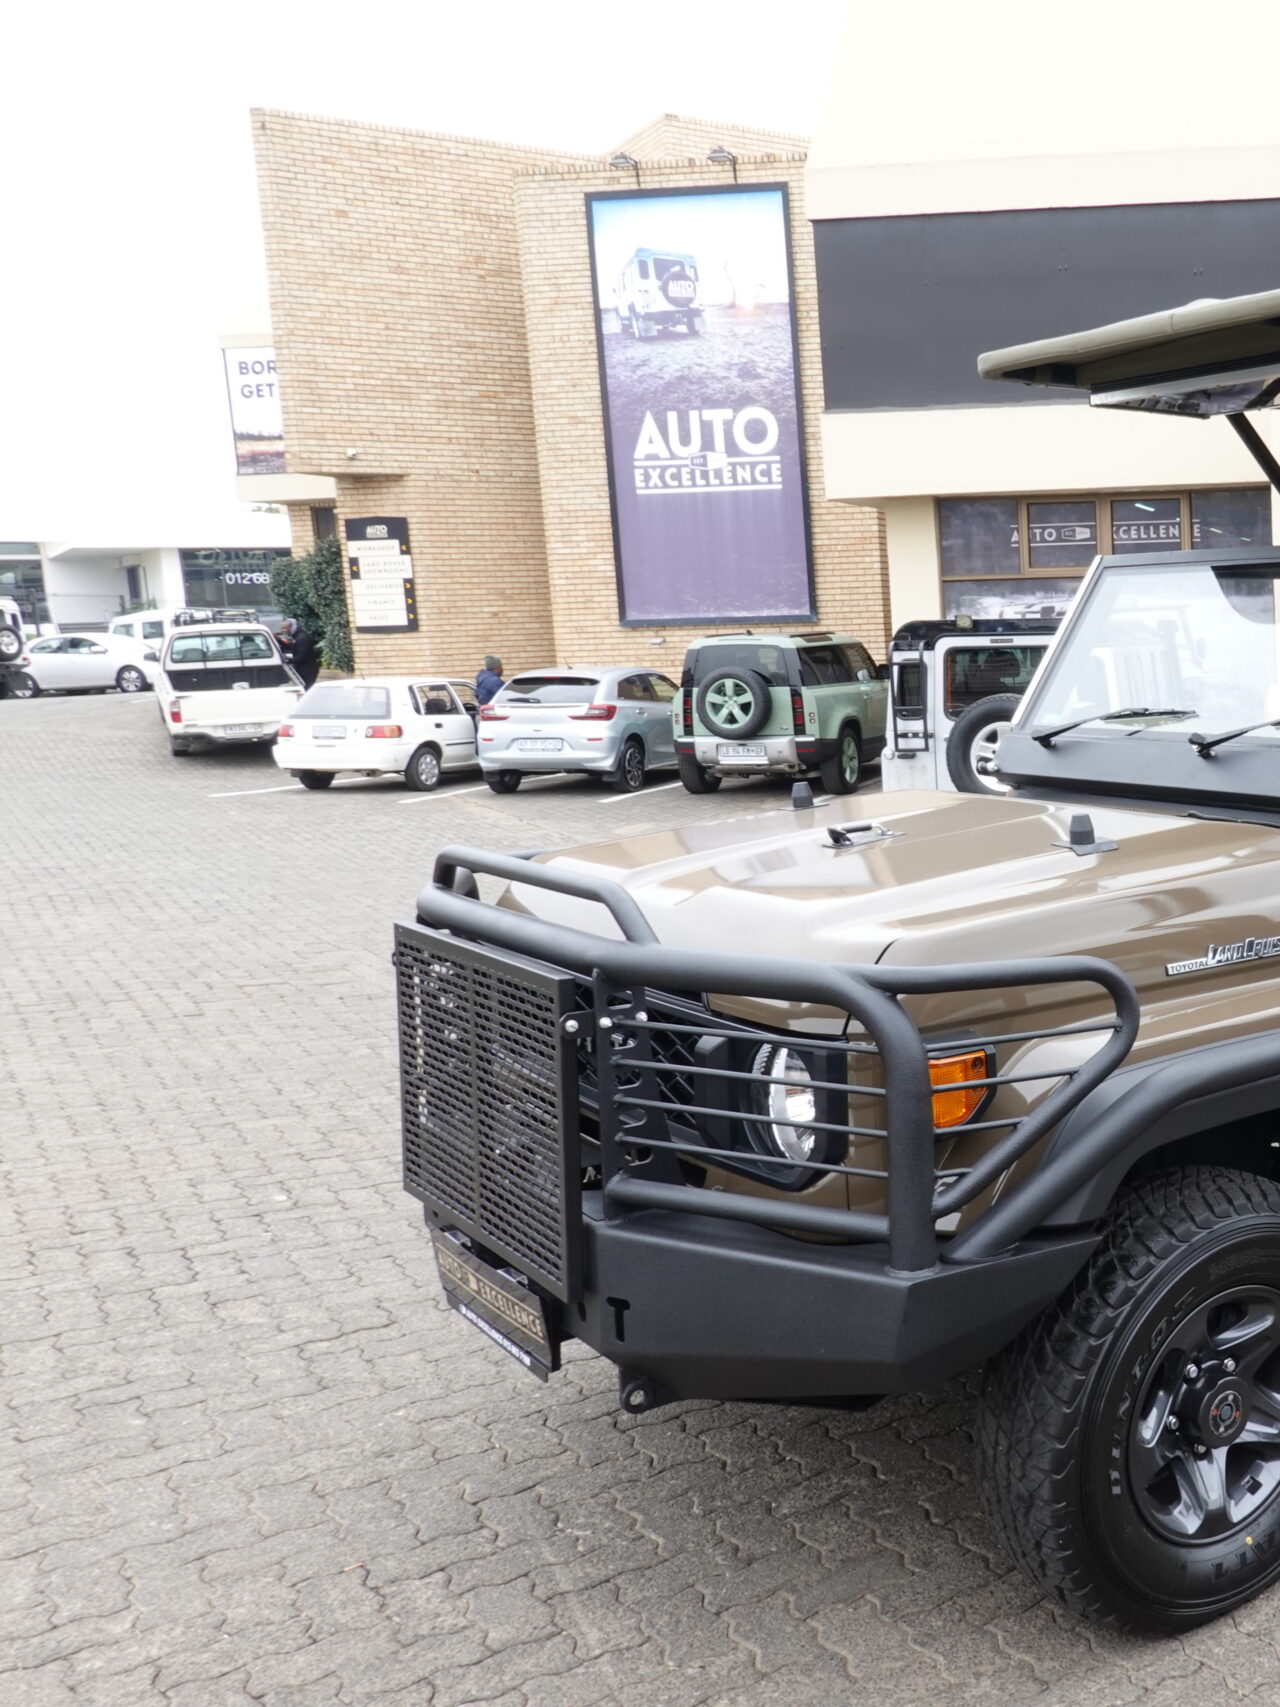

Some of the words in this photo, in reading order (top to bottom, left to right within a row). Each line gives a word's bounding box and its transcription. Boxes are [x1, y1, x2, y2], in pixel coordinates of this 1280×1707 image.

[238, 360, 277, 375] BOR
[240, 383, 275, 399] GET
[633, 406, 779, 459] AUTO
[634, 463, 783, 488] EXCELLENCE
[1011, 528, 1057, 543] ATO
[1170, 961, 1206, 973] TOYOTA
[479, 1280, 543, 1337] EXCELLENCE
